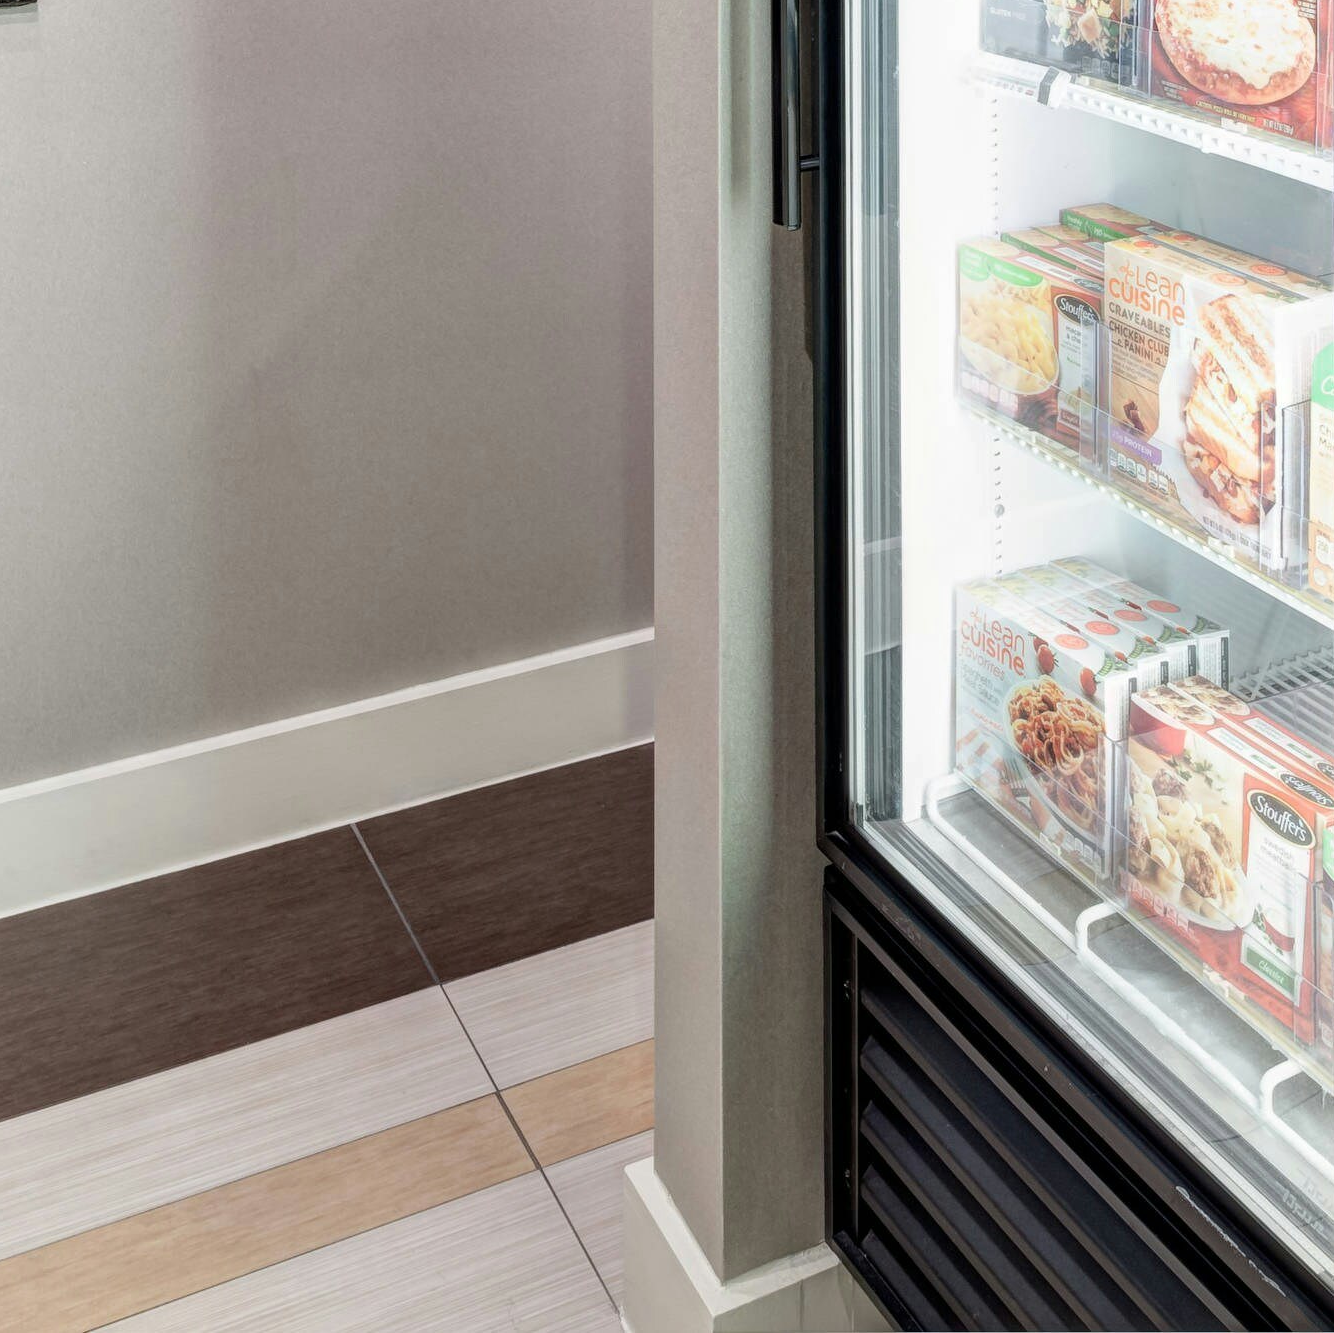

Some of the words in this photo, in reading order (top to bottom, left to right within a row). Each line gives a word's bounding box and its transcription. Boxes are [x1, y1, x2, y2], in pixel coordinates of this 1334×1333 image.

[1136, 265, 1185, 305] Lean
[1108, 301, 1170, 339] CRAVEABLES
[1108, 319, 1146, 345] CHICKEN
[1147, 335, 1170, 357] CLUB
[1124, 339, 1154, 362] PANINI
[1123, 435, 1153, 458] PROTEIN
[983, 612, 1025, 657] Lean
